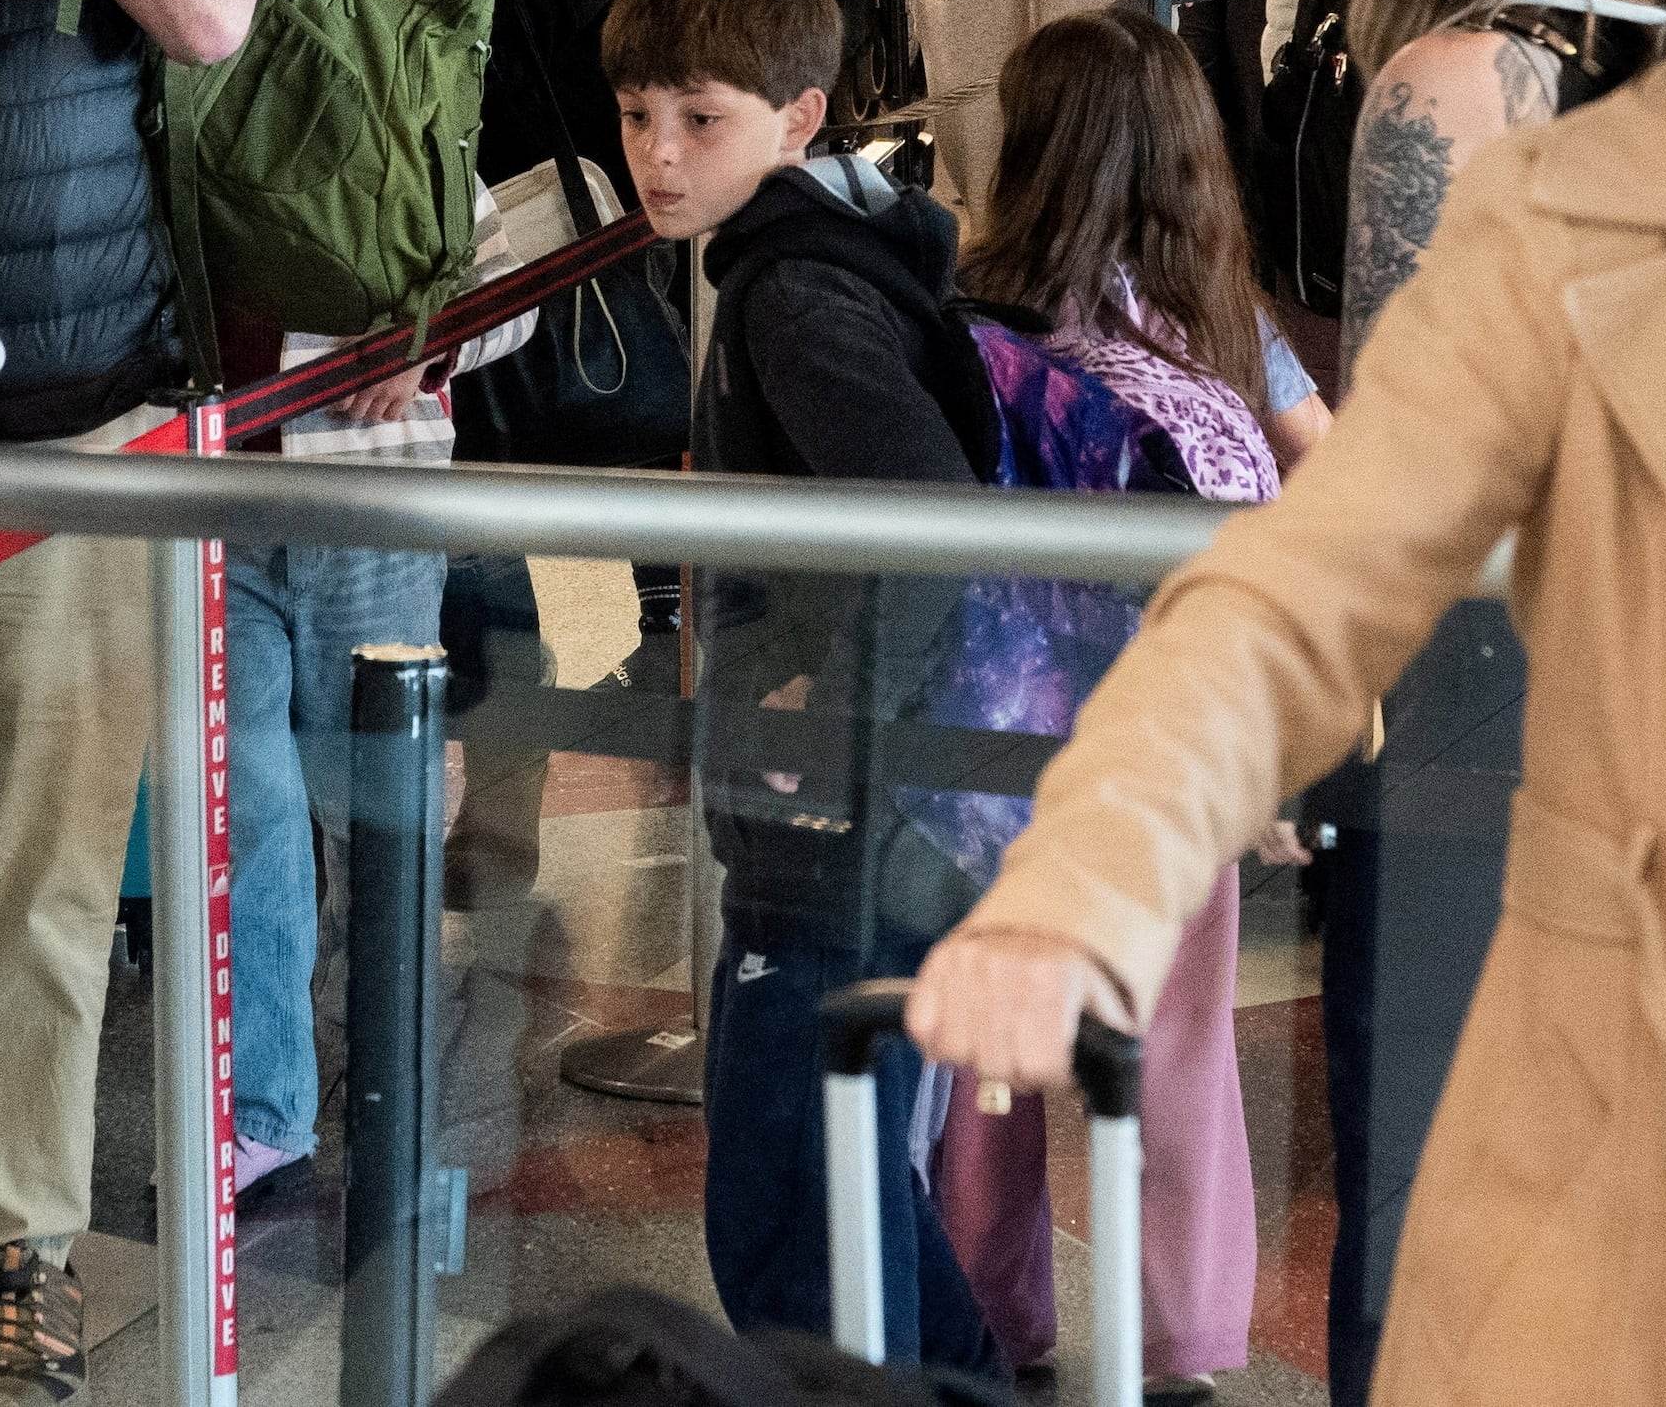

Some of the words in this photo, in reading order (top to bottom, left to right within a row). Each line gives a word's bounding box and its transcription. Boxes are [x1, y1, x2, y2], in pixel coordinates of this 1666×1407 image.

[208, 626, 226, 836] REMOVE
[215, 931, 230, 996] DO
[217, 1016, 232, 1117] NOT
[219, 1140, 236, 1347] REMOVE
